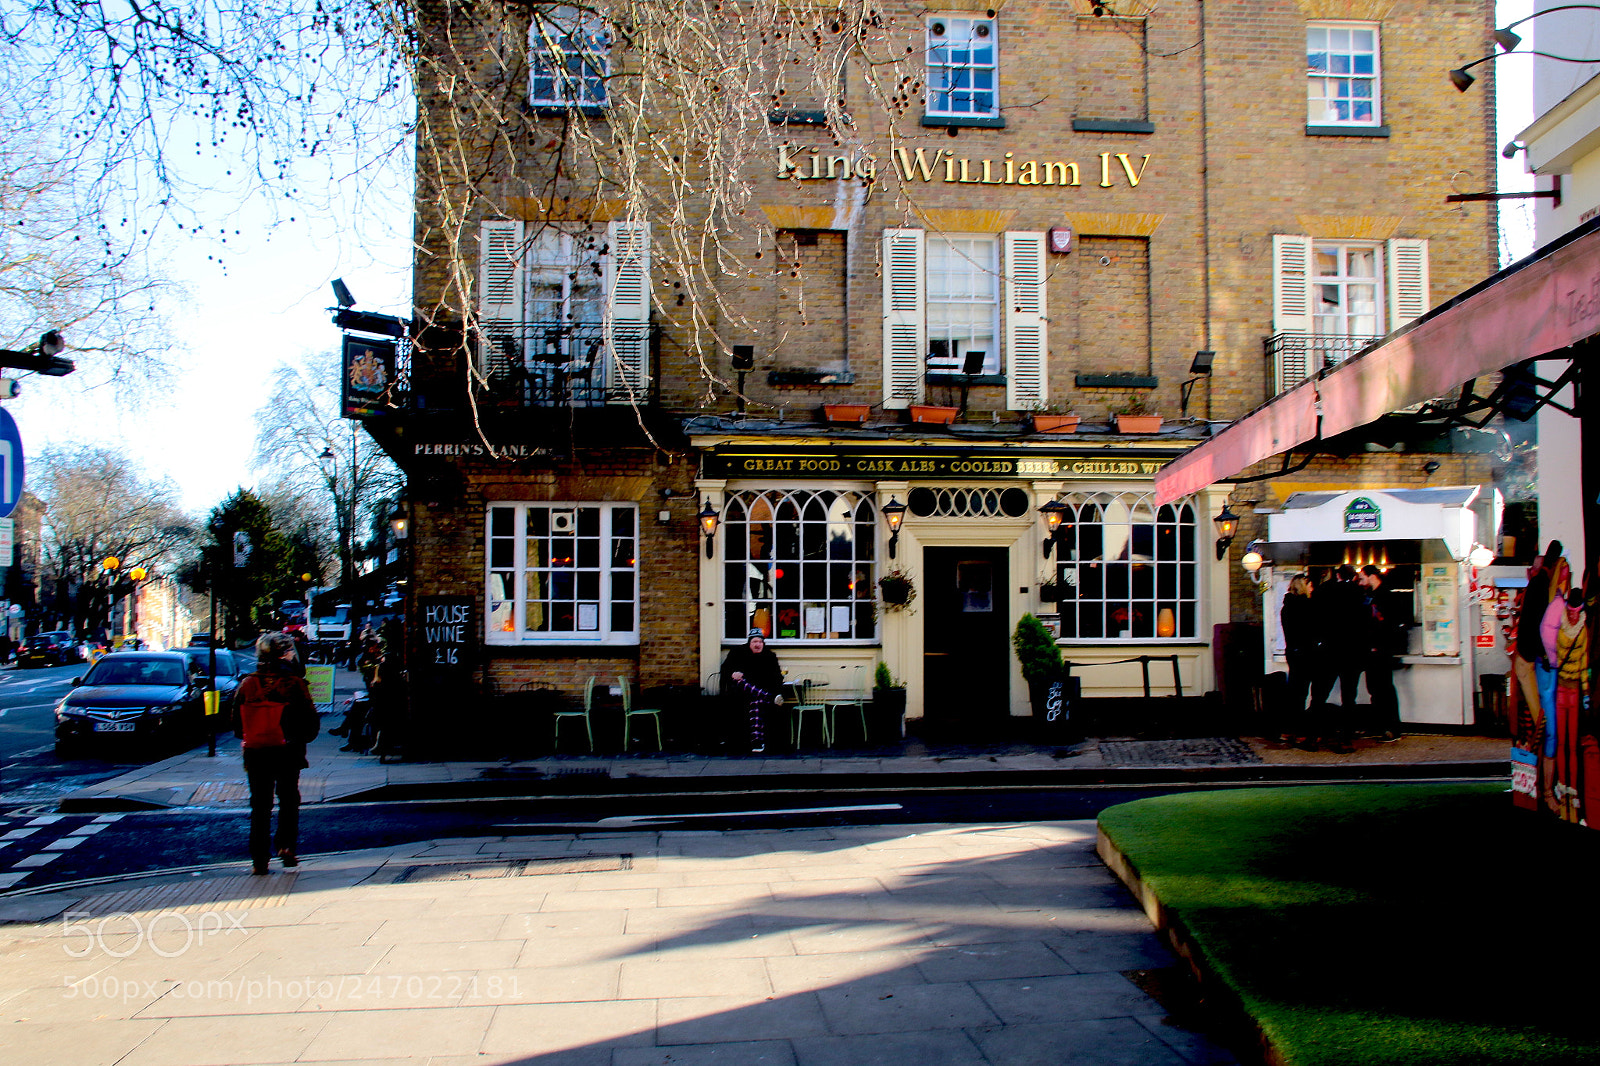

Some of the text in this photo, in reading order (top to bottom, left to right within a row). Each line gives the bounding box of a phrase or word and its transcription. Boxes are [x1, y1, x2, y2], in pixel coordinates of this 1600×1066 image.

[776, 145, 877, 206] King
[1099, 151, 1151, 188] IV
[414, 443, 484, 455] PERRIN'S
[490, 444, 529, 456] LANE
[743, 459, 1166, 474] GREAT FOOD CASK ALES COOLED BEERS CHILLED WI
[426, 604, 470, 624] HOUSE
[425, 625, 465, 644] WINE
[435, 648, 459, 665] £16
